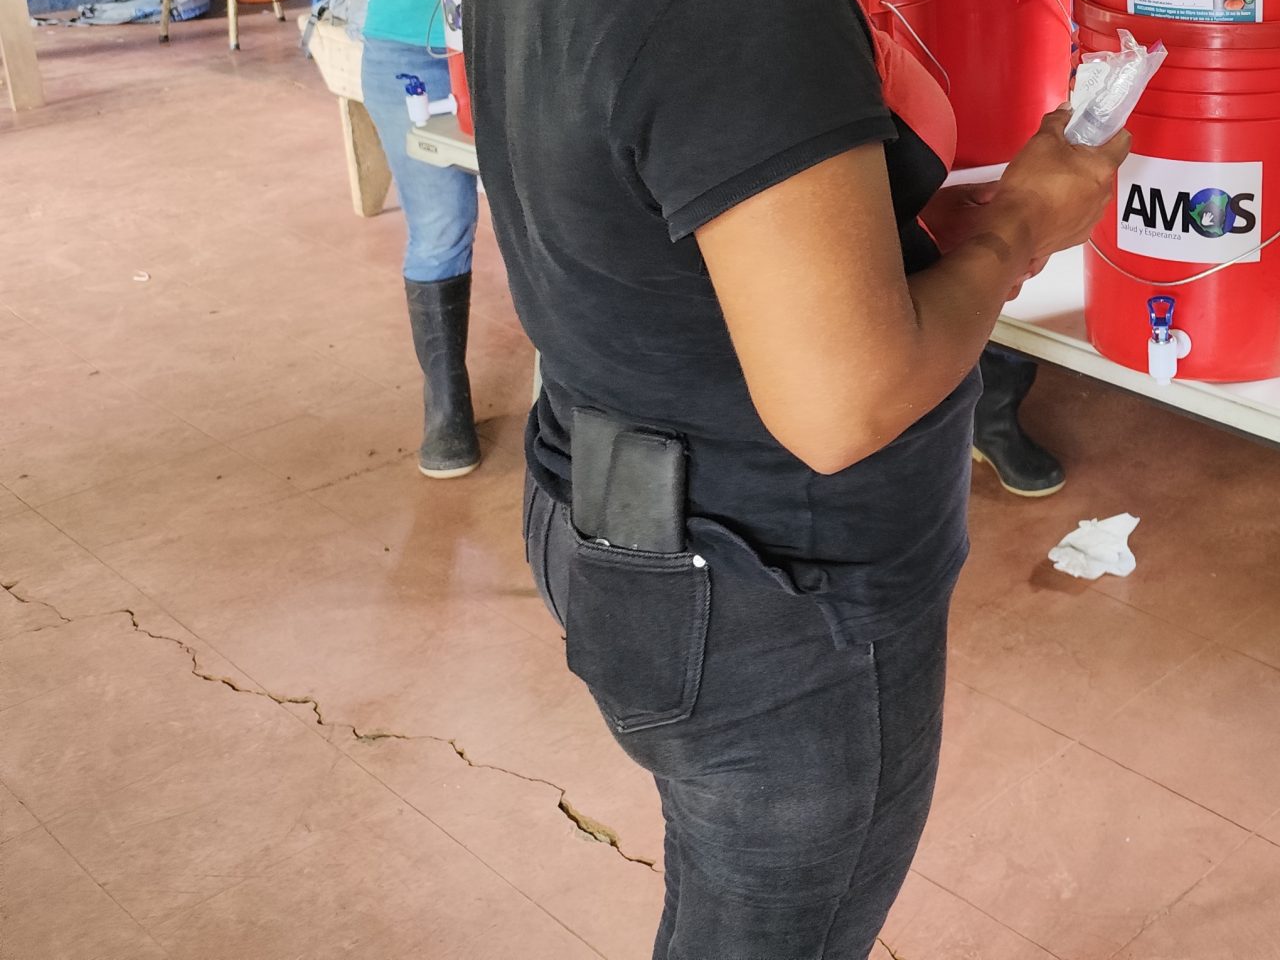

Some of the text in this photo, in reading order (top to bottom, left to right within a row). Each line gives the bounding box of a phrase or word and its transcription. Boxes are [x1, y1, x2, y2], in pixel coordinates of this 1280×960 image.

[1122, 183, 1256, 238] AMOS
[1120, 222, 1138, 233] Salud
[1144, 227, 1182, 240] Esperanza
